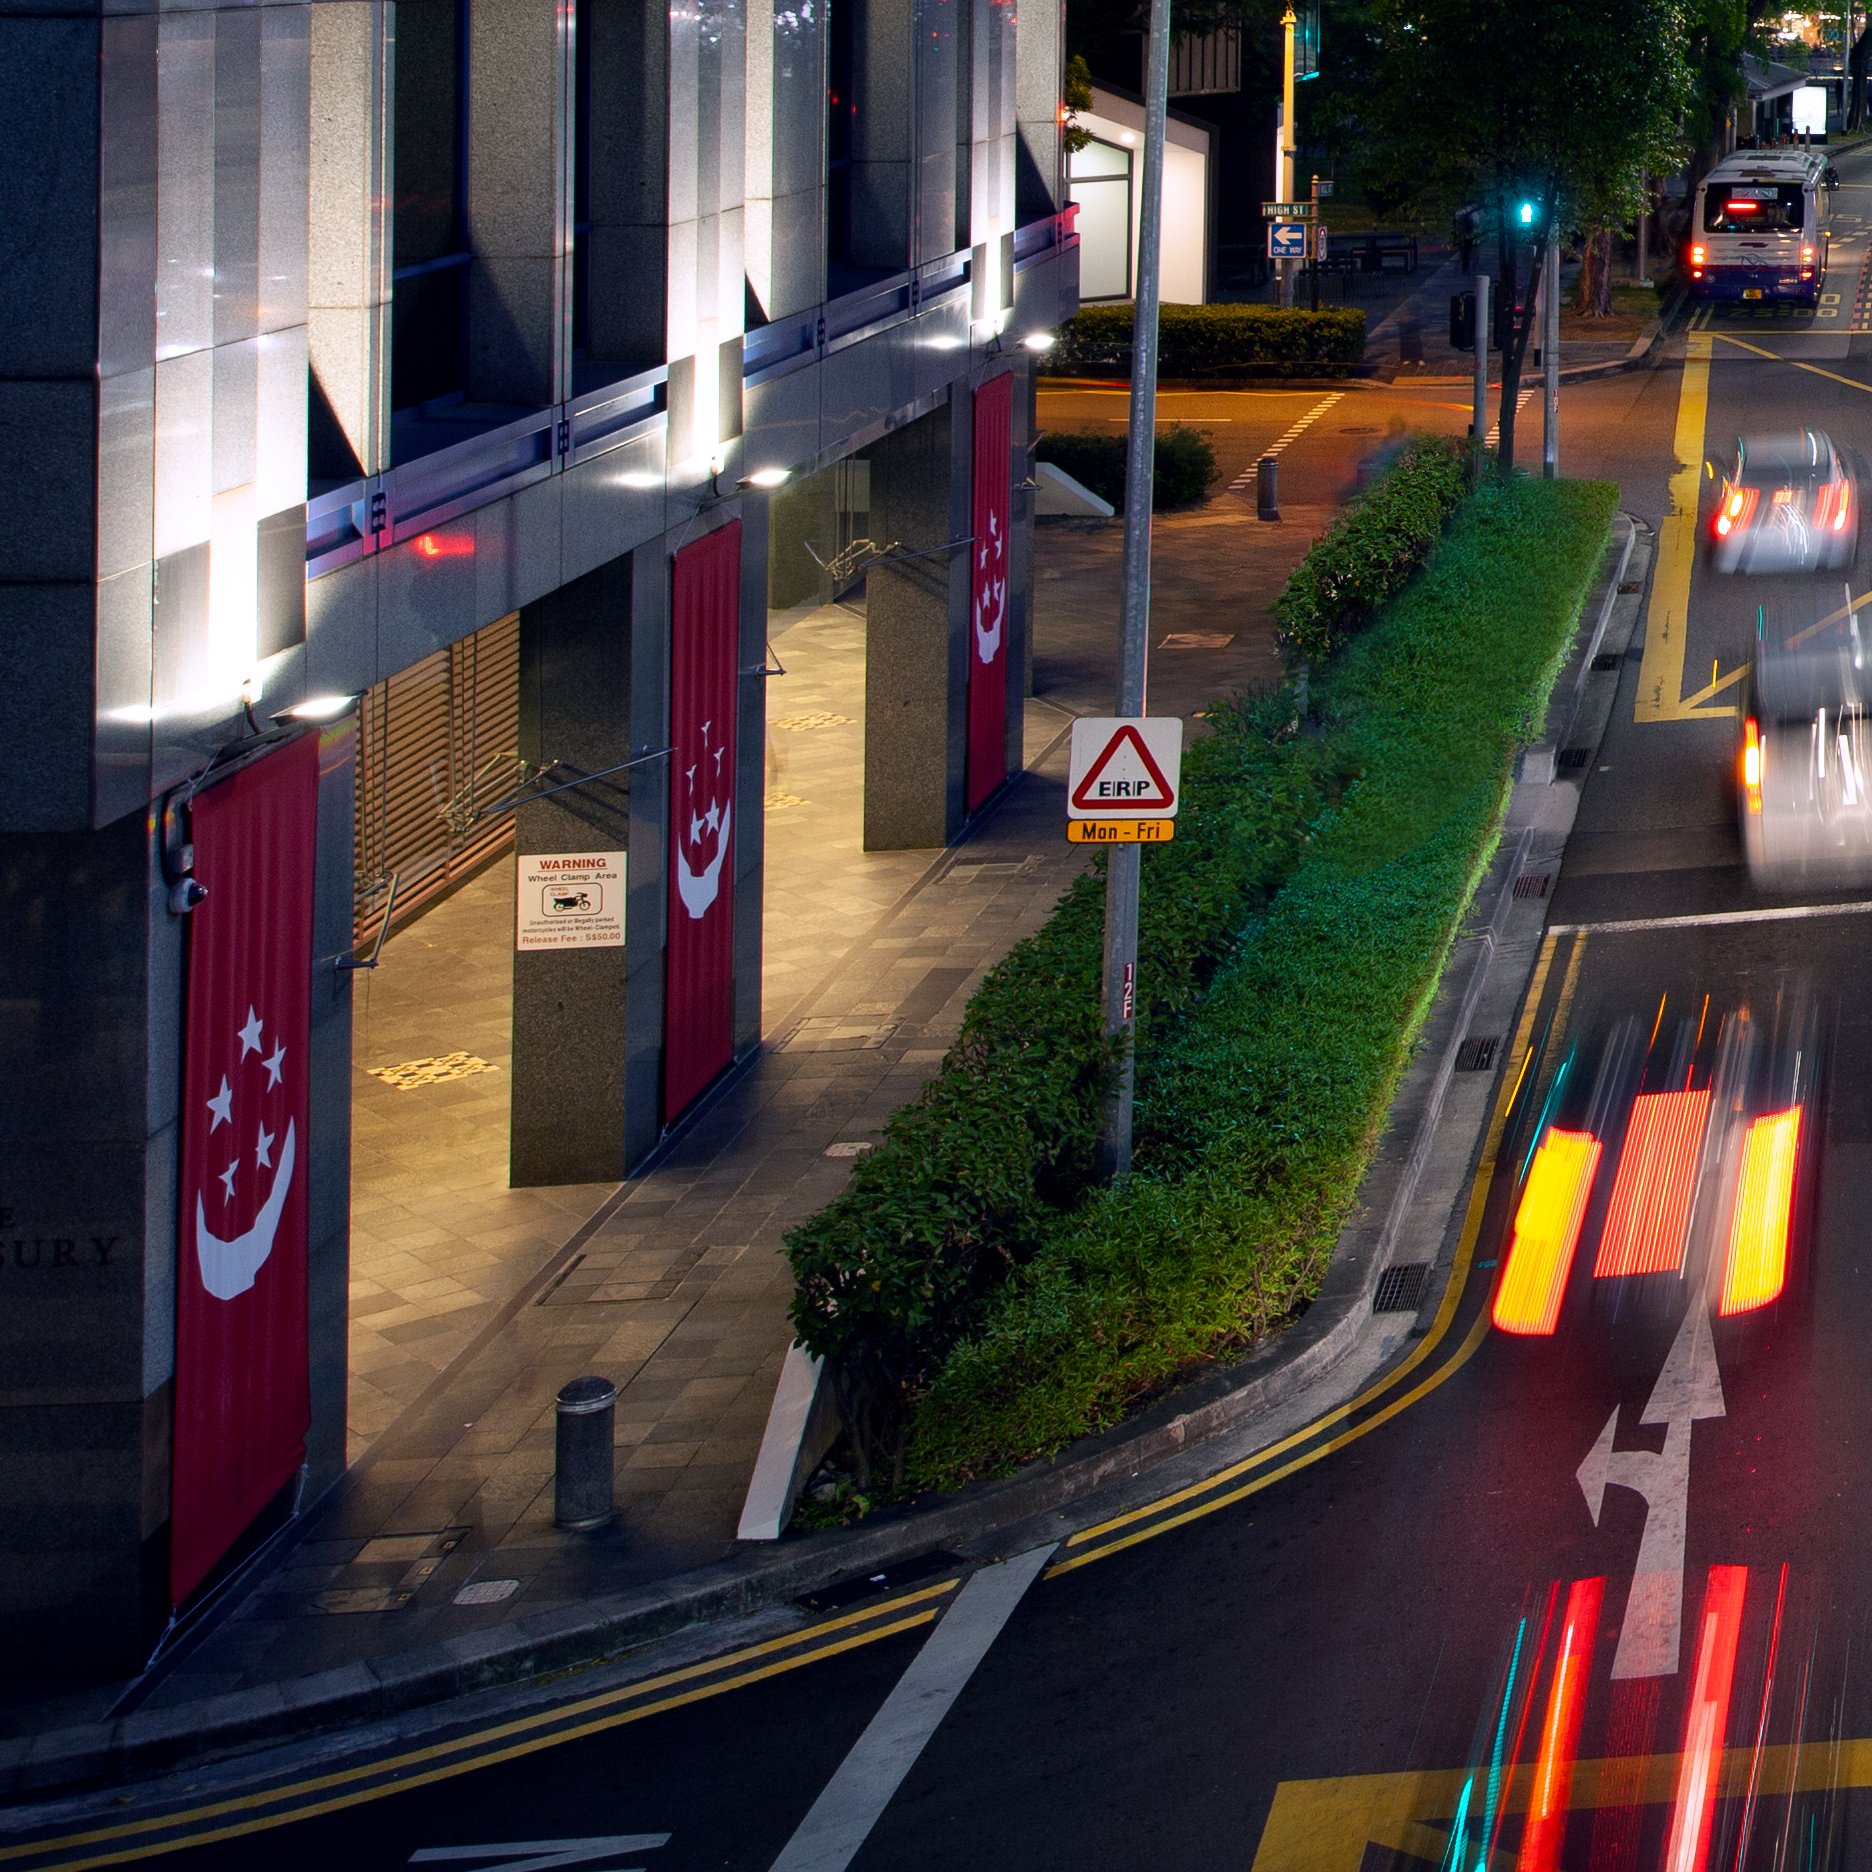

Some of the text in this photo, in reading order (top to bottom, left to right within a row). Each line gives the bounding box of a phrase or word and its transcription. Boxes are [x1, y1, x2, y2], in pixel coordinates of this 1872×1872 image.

[1267, 205, 1304, 215] HIGH ST
[1082, 823, 1117, 839] Mon
[1137, 822, 1160, 839] Fri
[540, 858, 607, 870] WARNING
[561, 873, 590, 881] Clamp
[595, 872, 618, 880] Area
[522, 936, 558, 944] Release
[585, 933, 621, 941] S$50.00
